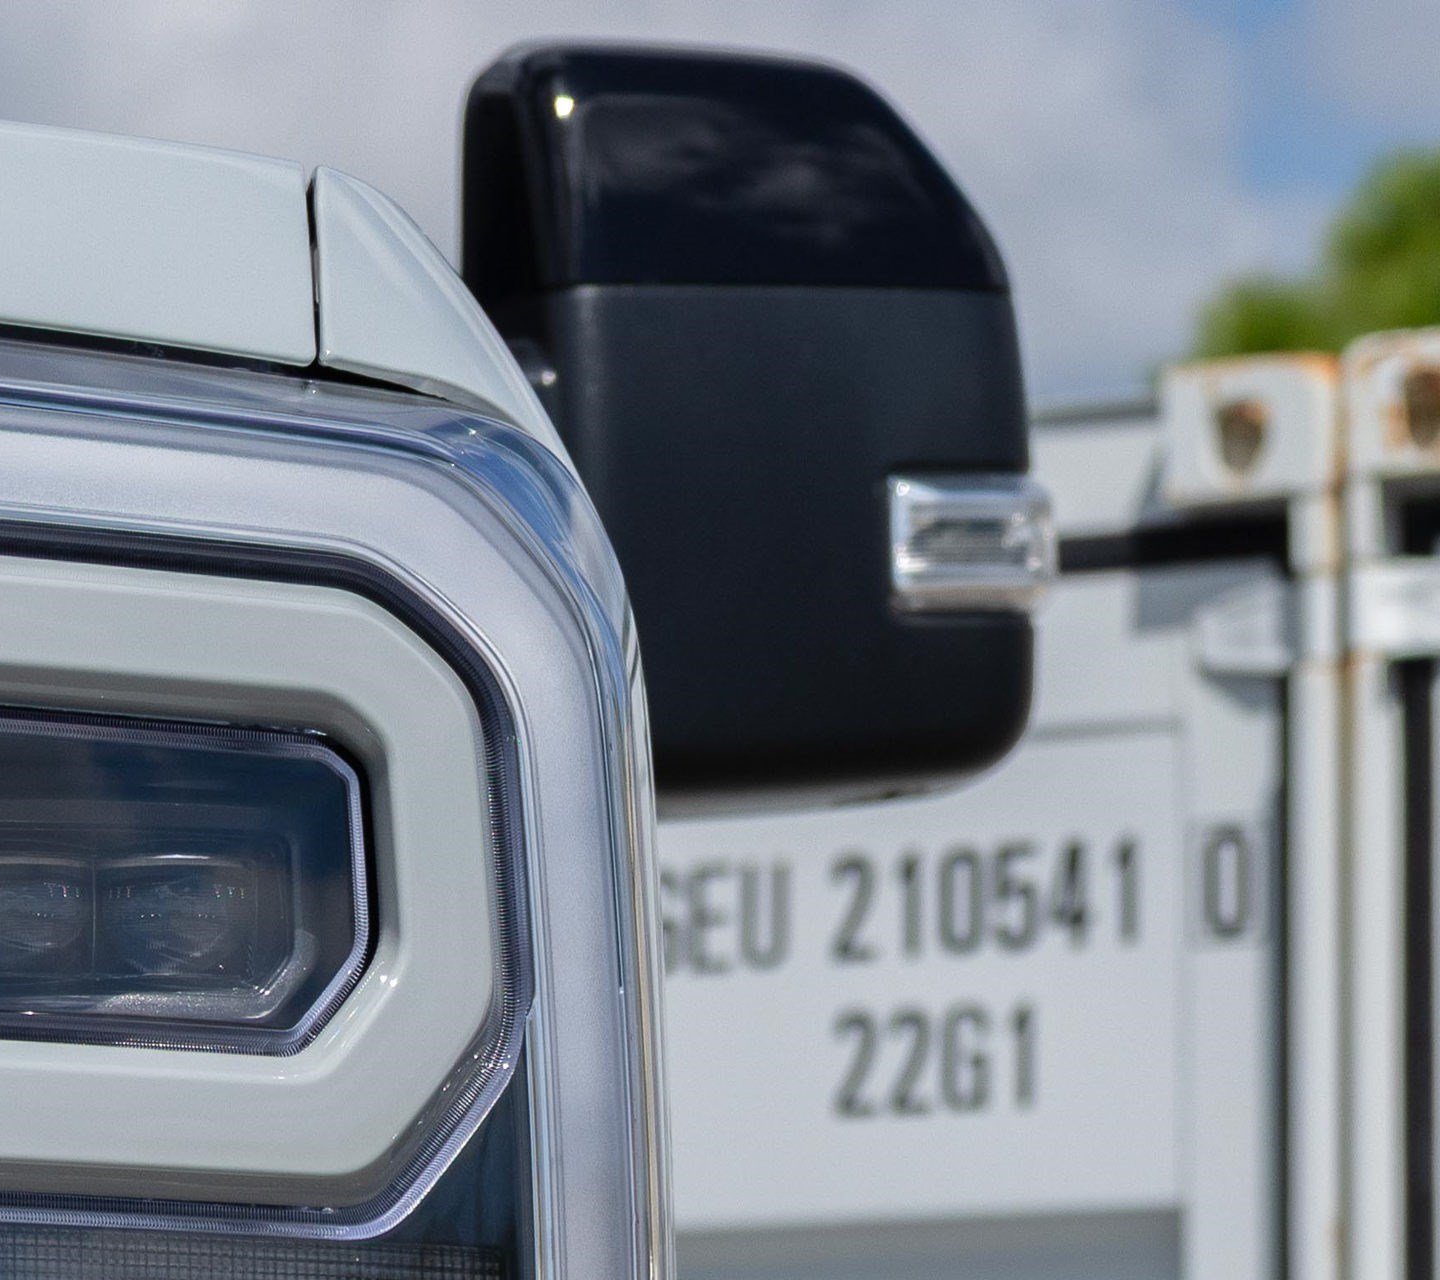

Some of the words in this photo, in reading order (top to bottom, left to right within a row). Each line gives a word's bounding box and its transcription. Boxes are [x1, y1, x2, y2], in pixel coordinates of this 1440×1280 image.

[830, 838, 1141, 965] 210541
[1201, 822, 1250, 942] 0
[831, 1003, 1038, 1119] 22G1
